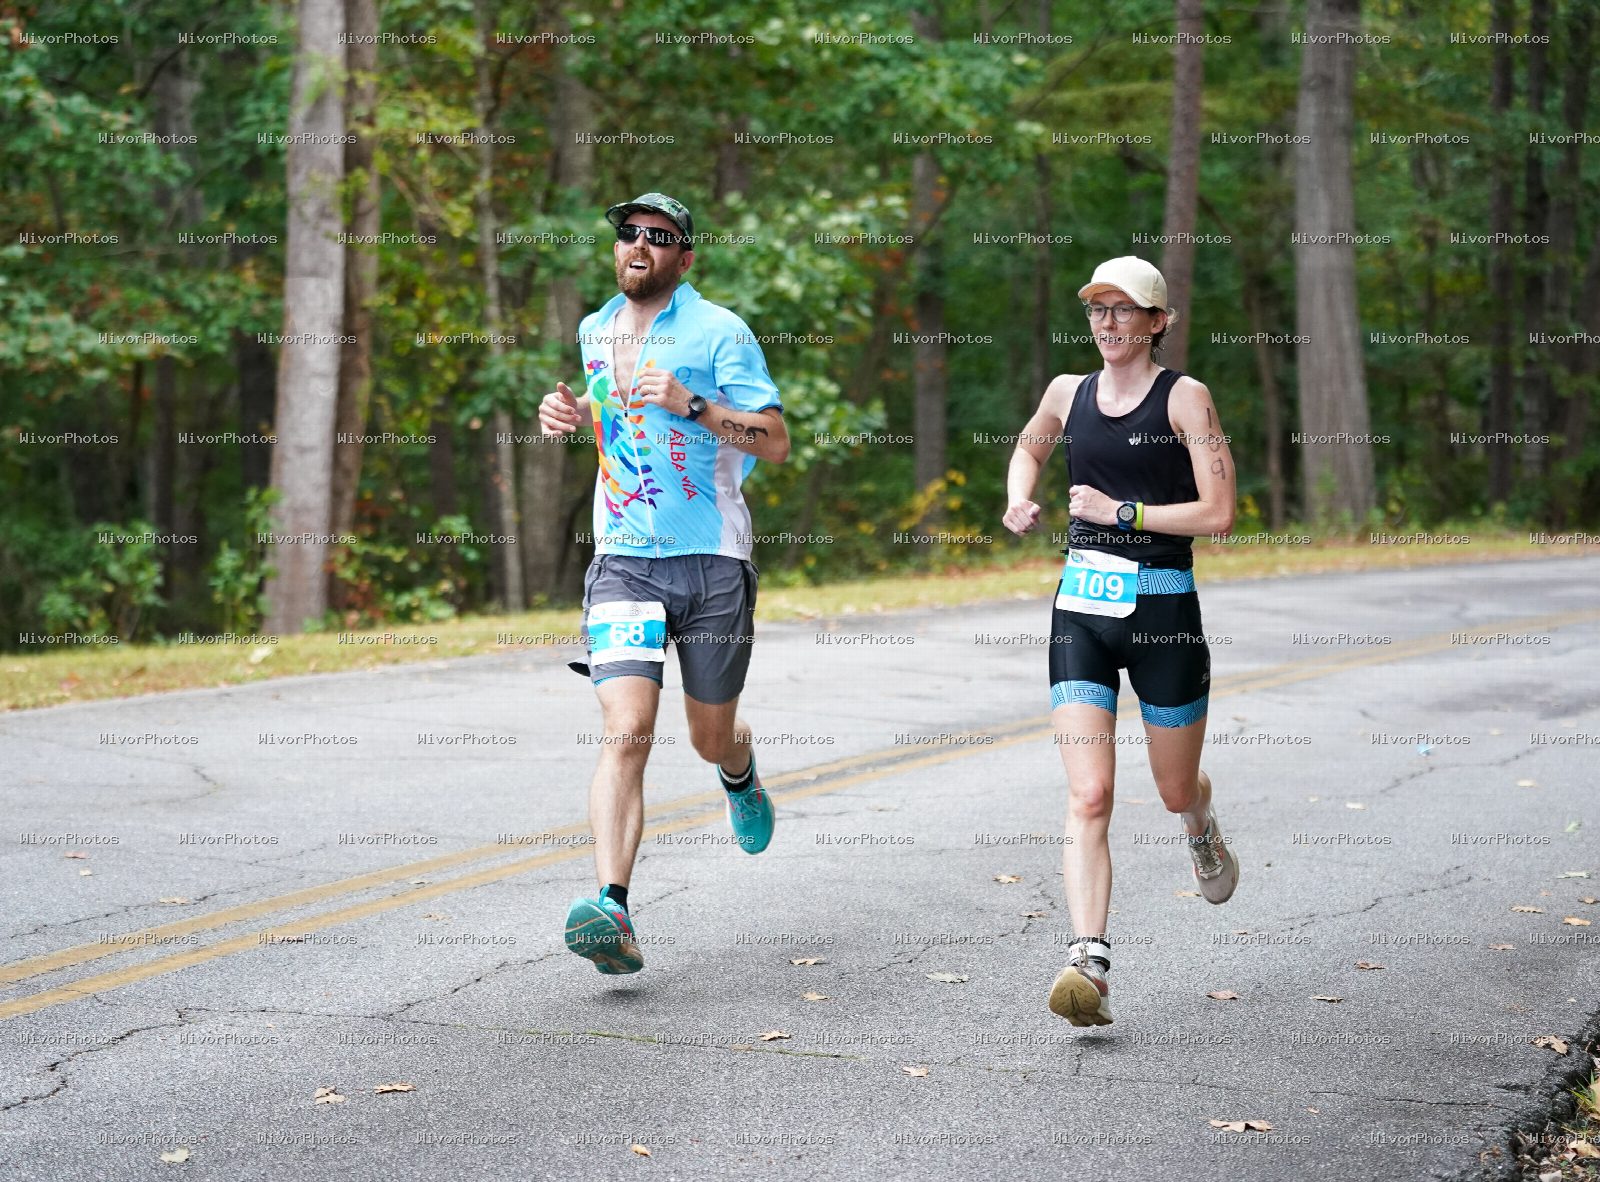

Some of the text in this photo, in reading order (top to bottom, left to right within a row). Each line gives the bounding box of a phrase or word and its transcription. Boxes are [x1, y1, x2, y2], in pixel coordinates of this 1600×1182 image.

[1206, 407, 1226, 481] 109
[1075, 570, 1125, 601] 109
[610, 623, 646, 646] 68
